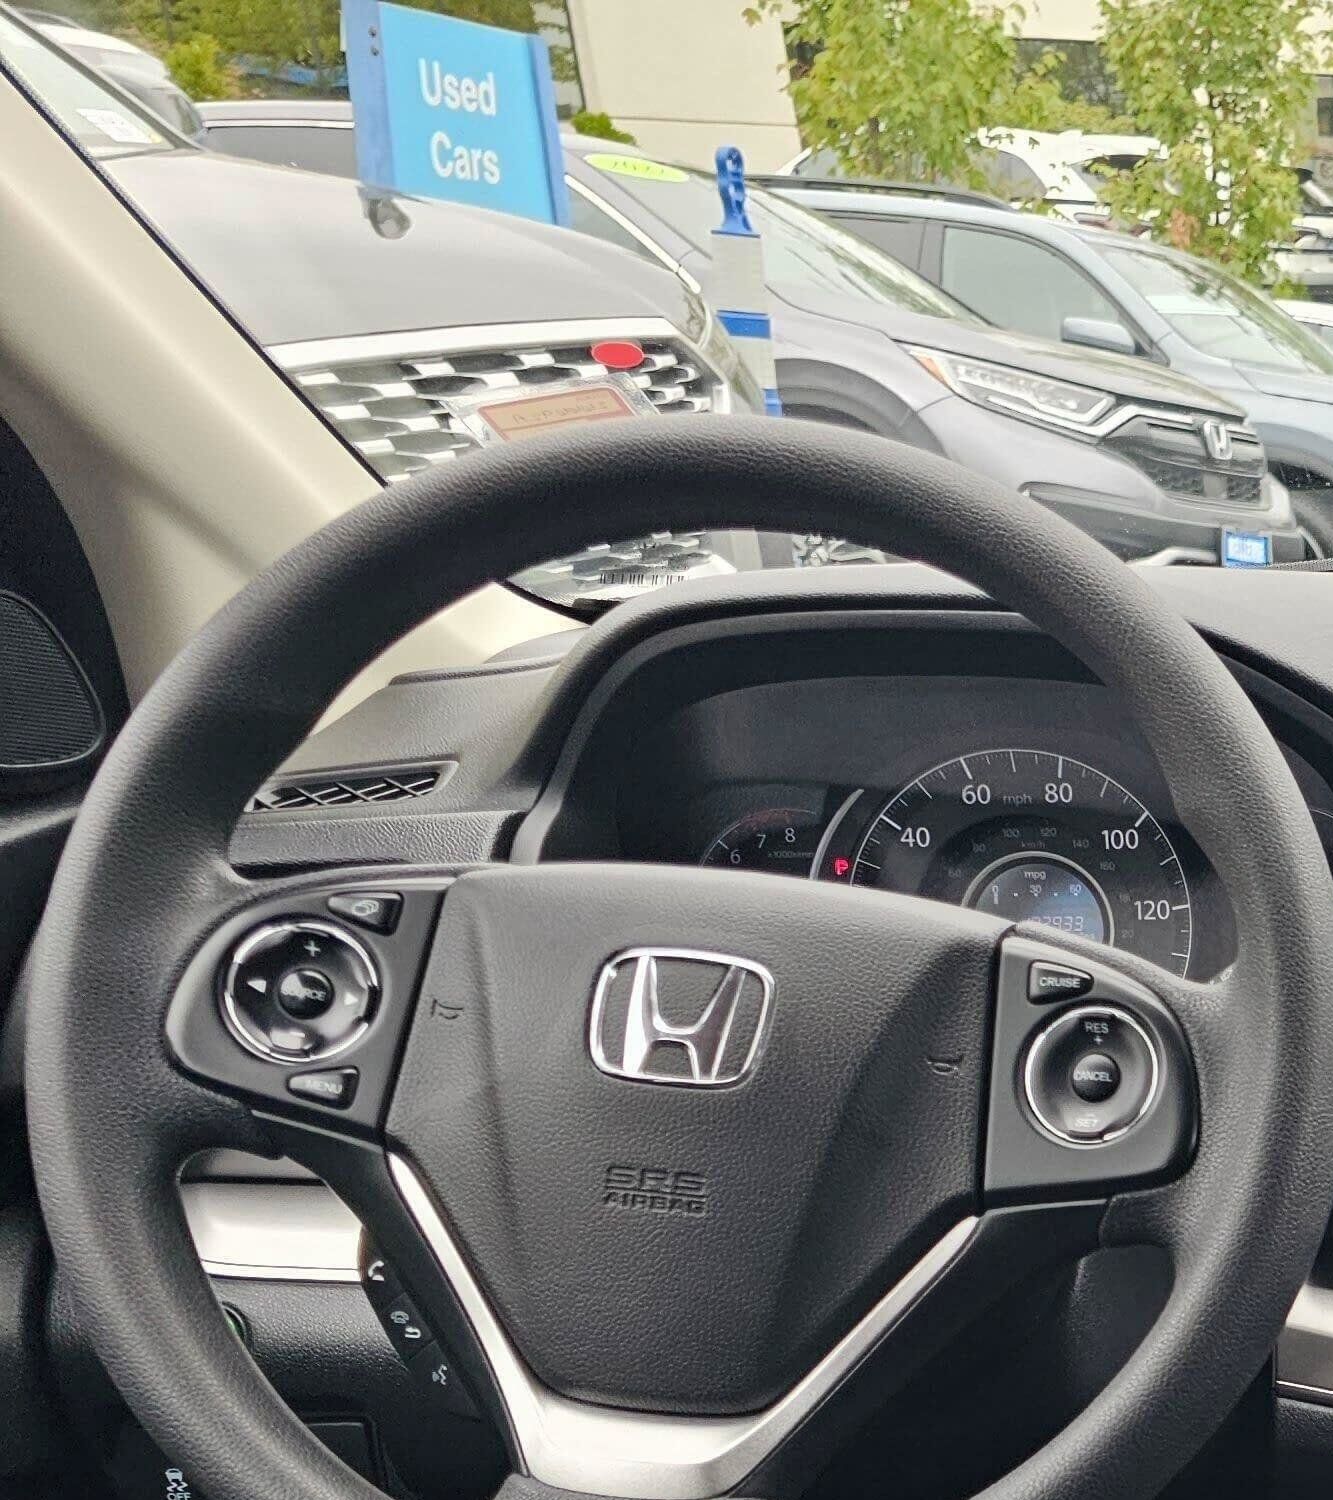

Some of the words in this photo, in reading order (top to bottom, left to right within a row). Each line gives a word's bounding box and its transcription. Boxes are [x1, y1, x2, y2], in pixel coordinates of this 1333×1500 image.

[418, 57, 497, 117] Used
[430, 130, 501, 185] Cars
[962, 784, 991, 805] 60
[1003, 793, 1033, 806] mph
[1044, 782, 1073, 804] 80
[756, 834, 767, 849] 7
[785, 827, 796, 843] 8
[900, 826, 931, 848] 40
[1101, 829, 1139, 850] 100
[730, 849, 741, 864] 6
[1024, 870, 1047, 880] mpg
[1029, 884, 1042, 894] 30
[1134, 899, 1170, 921] 120
[1039, 976, 1081, 989] CRUISE
[1085, 1021, 1110, 1034] RES
[1073, 1070, 1113, 1083] CANCEL
[302, 1078, 343, 1096] MENU
[605, 1166, 706, 1192] SRS
[603, 1191, 707, 1216] AIRBAG
